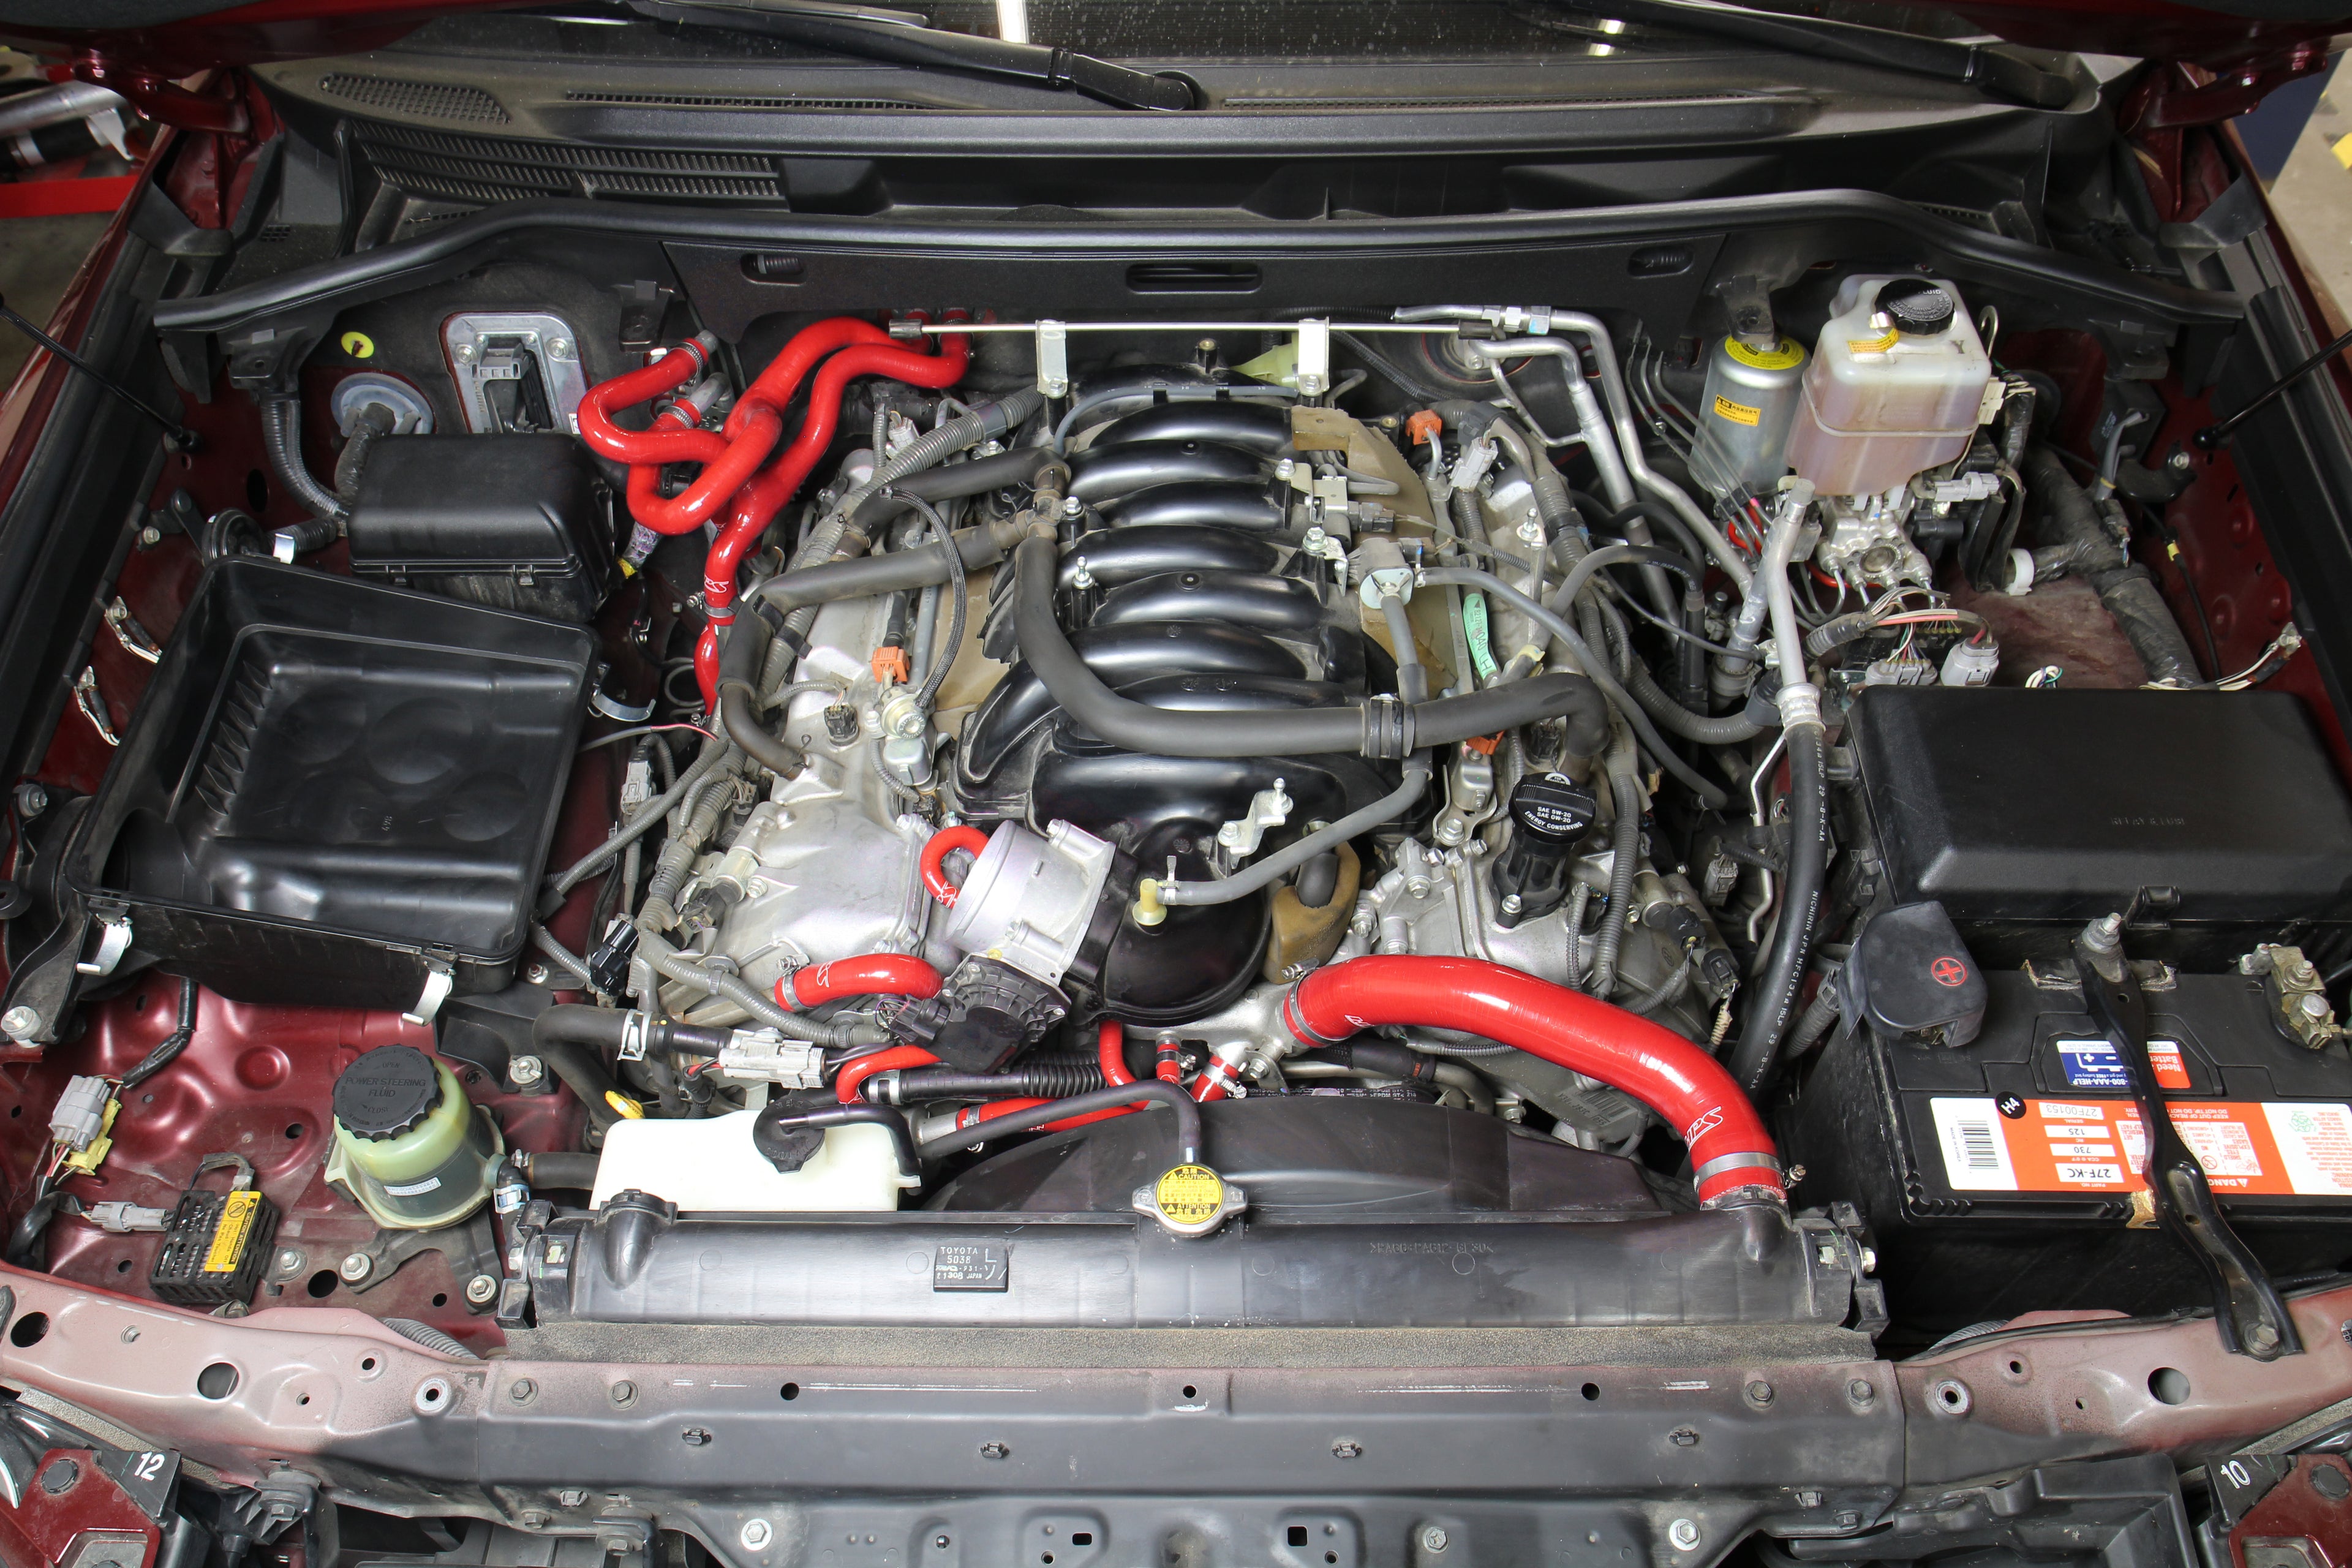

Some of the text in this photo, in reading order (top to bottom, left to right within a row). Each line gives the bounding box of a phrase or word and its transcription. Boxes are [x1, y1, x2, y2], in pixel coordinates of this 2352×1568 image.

[1550, 814, 1571, 823] 0W-20
[1551, 809, 1572, 818] 5W-20
[1524, 810, 1583, 831] ENERGY CONSERVING
[1805, 890, 1819, 931] NICHIRIN
[380, 1078, 426, 1087] STEERING
[368, 1089, 396, 1098] FLUID
[2000, 1097, 2020, 1114] H4
[2046, 1105, 2097, 1117] 27F00153
[2067, 1168, 2111, 1178] 27F-KC
[231, 1212, 252, 1263] CAUTION ATTENTION
[940, 1246, 978, 1255] TOYOTA
[947, 1255, 971, 1264] 5038
[134, 1451, 165, 1480] 12
[2220, 1460, 2250, 1489] 10
